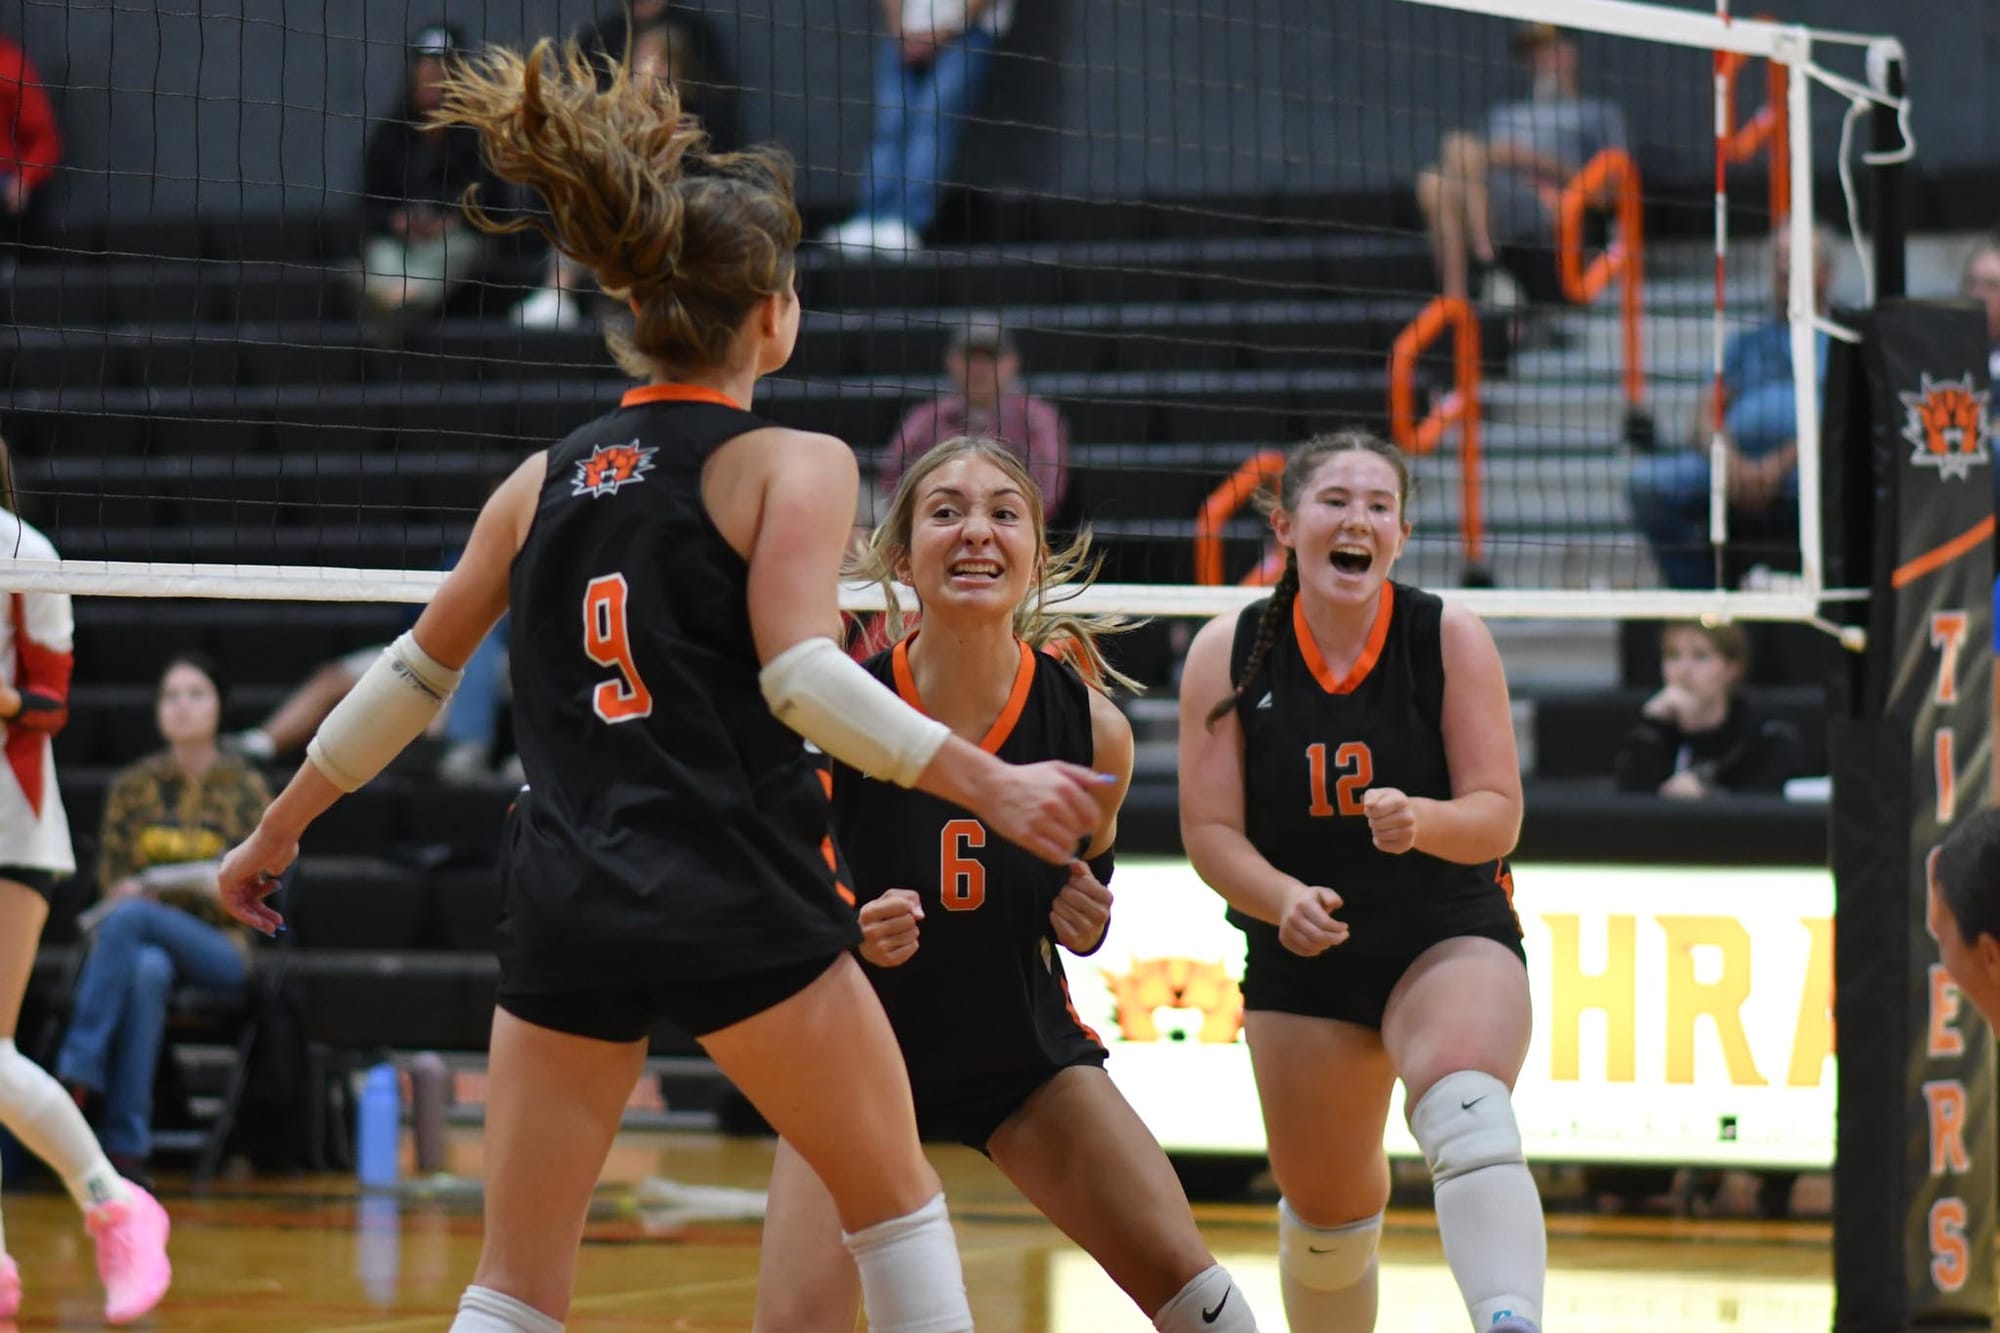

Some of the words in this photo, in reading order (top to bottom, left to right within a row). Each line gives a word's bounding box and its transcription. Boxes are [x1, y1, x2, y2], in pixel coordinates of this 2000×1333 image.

[583, 571, 653, 725] 9
[1306, 741, 1373, 817] 12
[940, 819, 986, 912] 6
[1923, 610, 1970, 1292] TIERS
